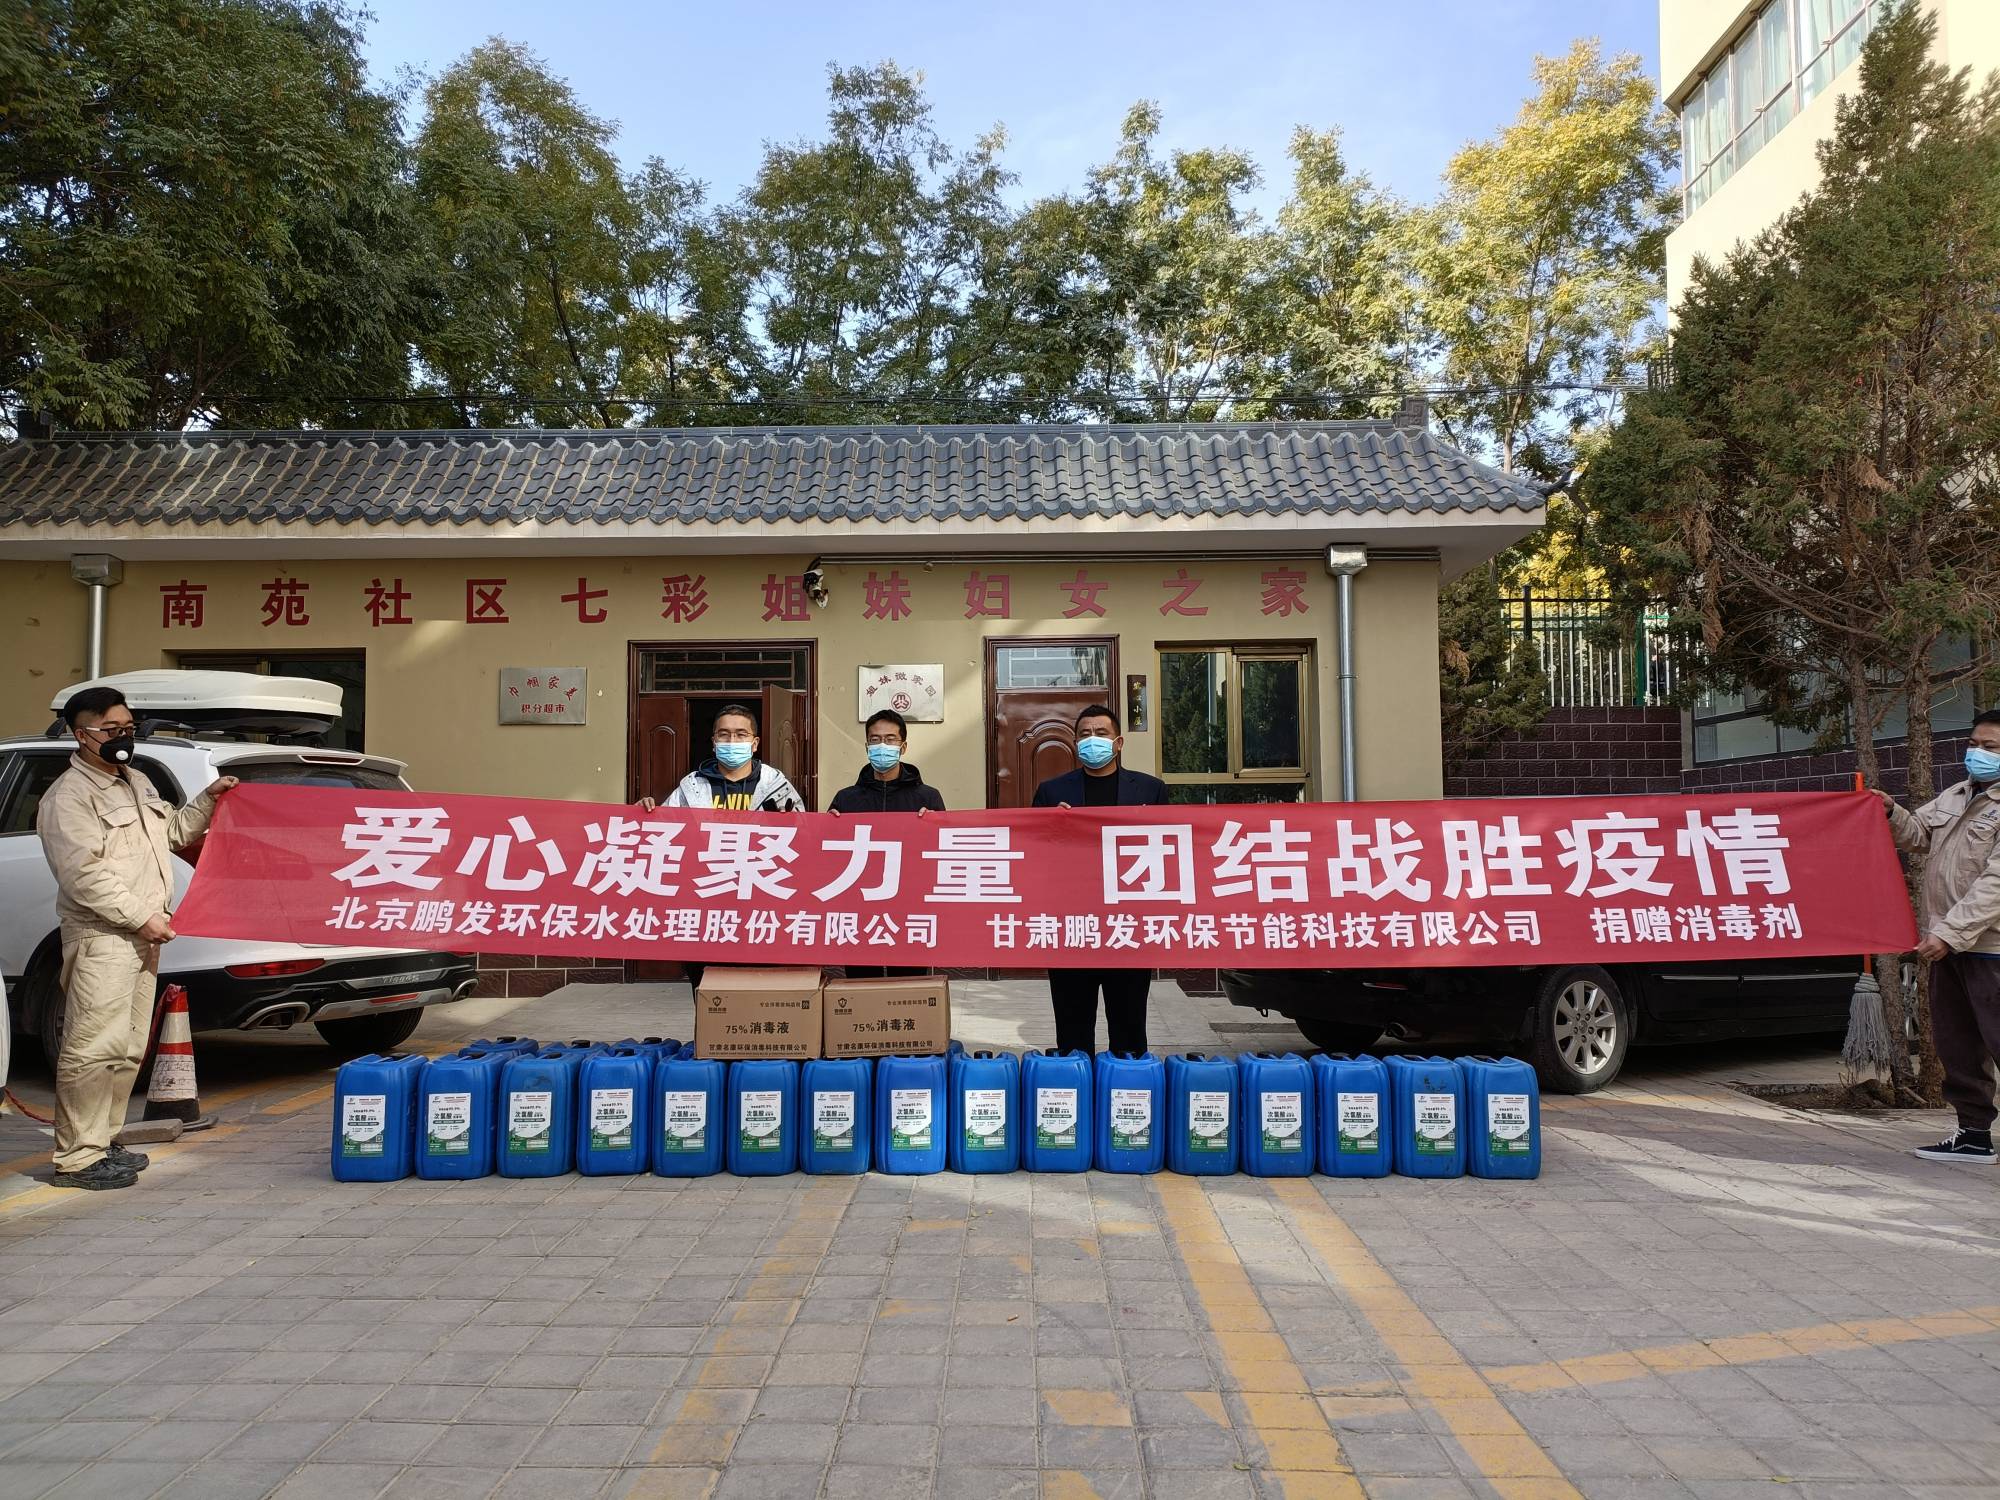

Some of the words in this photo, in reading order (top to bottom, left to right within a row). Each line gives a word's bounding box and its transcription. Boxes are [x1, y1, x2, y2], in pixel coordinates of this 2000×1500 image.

[159, 566, 1309, 629] 南苑社区七彩姐妹妇女之家
[520, 703, 566, 714] 积分超市
[331, 806, 1025, 904] 爱心凝聚力量
[1102, 808, 1795, 904] 团结战胜疫情
[325, 895, 939, 949] 北京鹏发环保水处理股份有限公司
[986, 909, 1543, 949] 甘肃鹏发环保节能科技有限公司
[1590, 903, 1803, 944] 捐赠消毒剂
